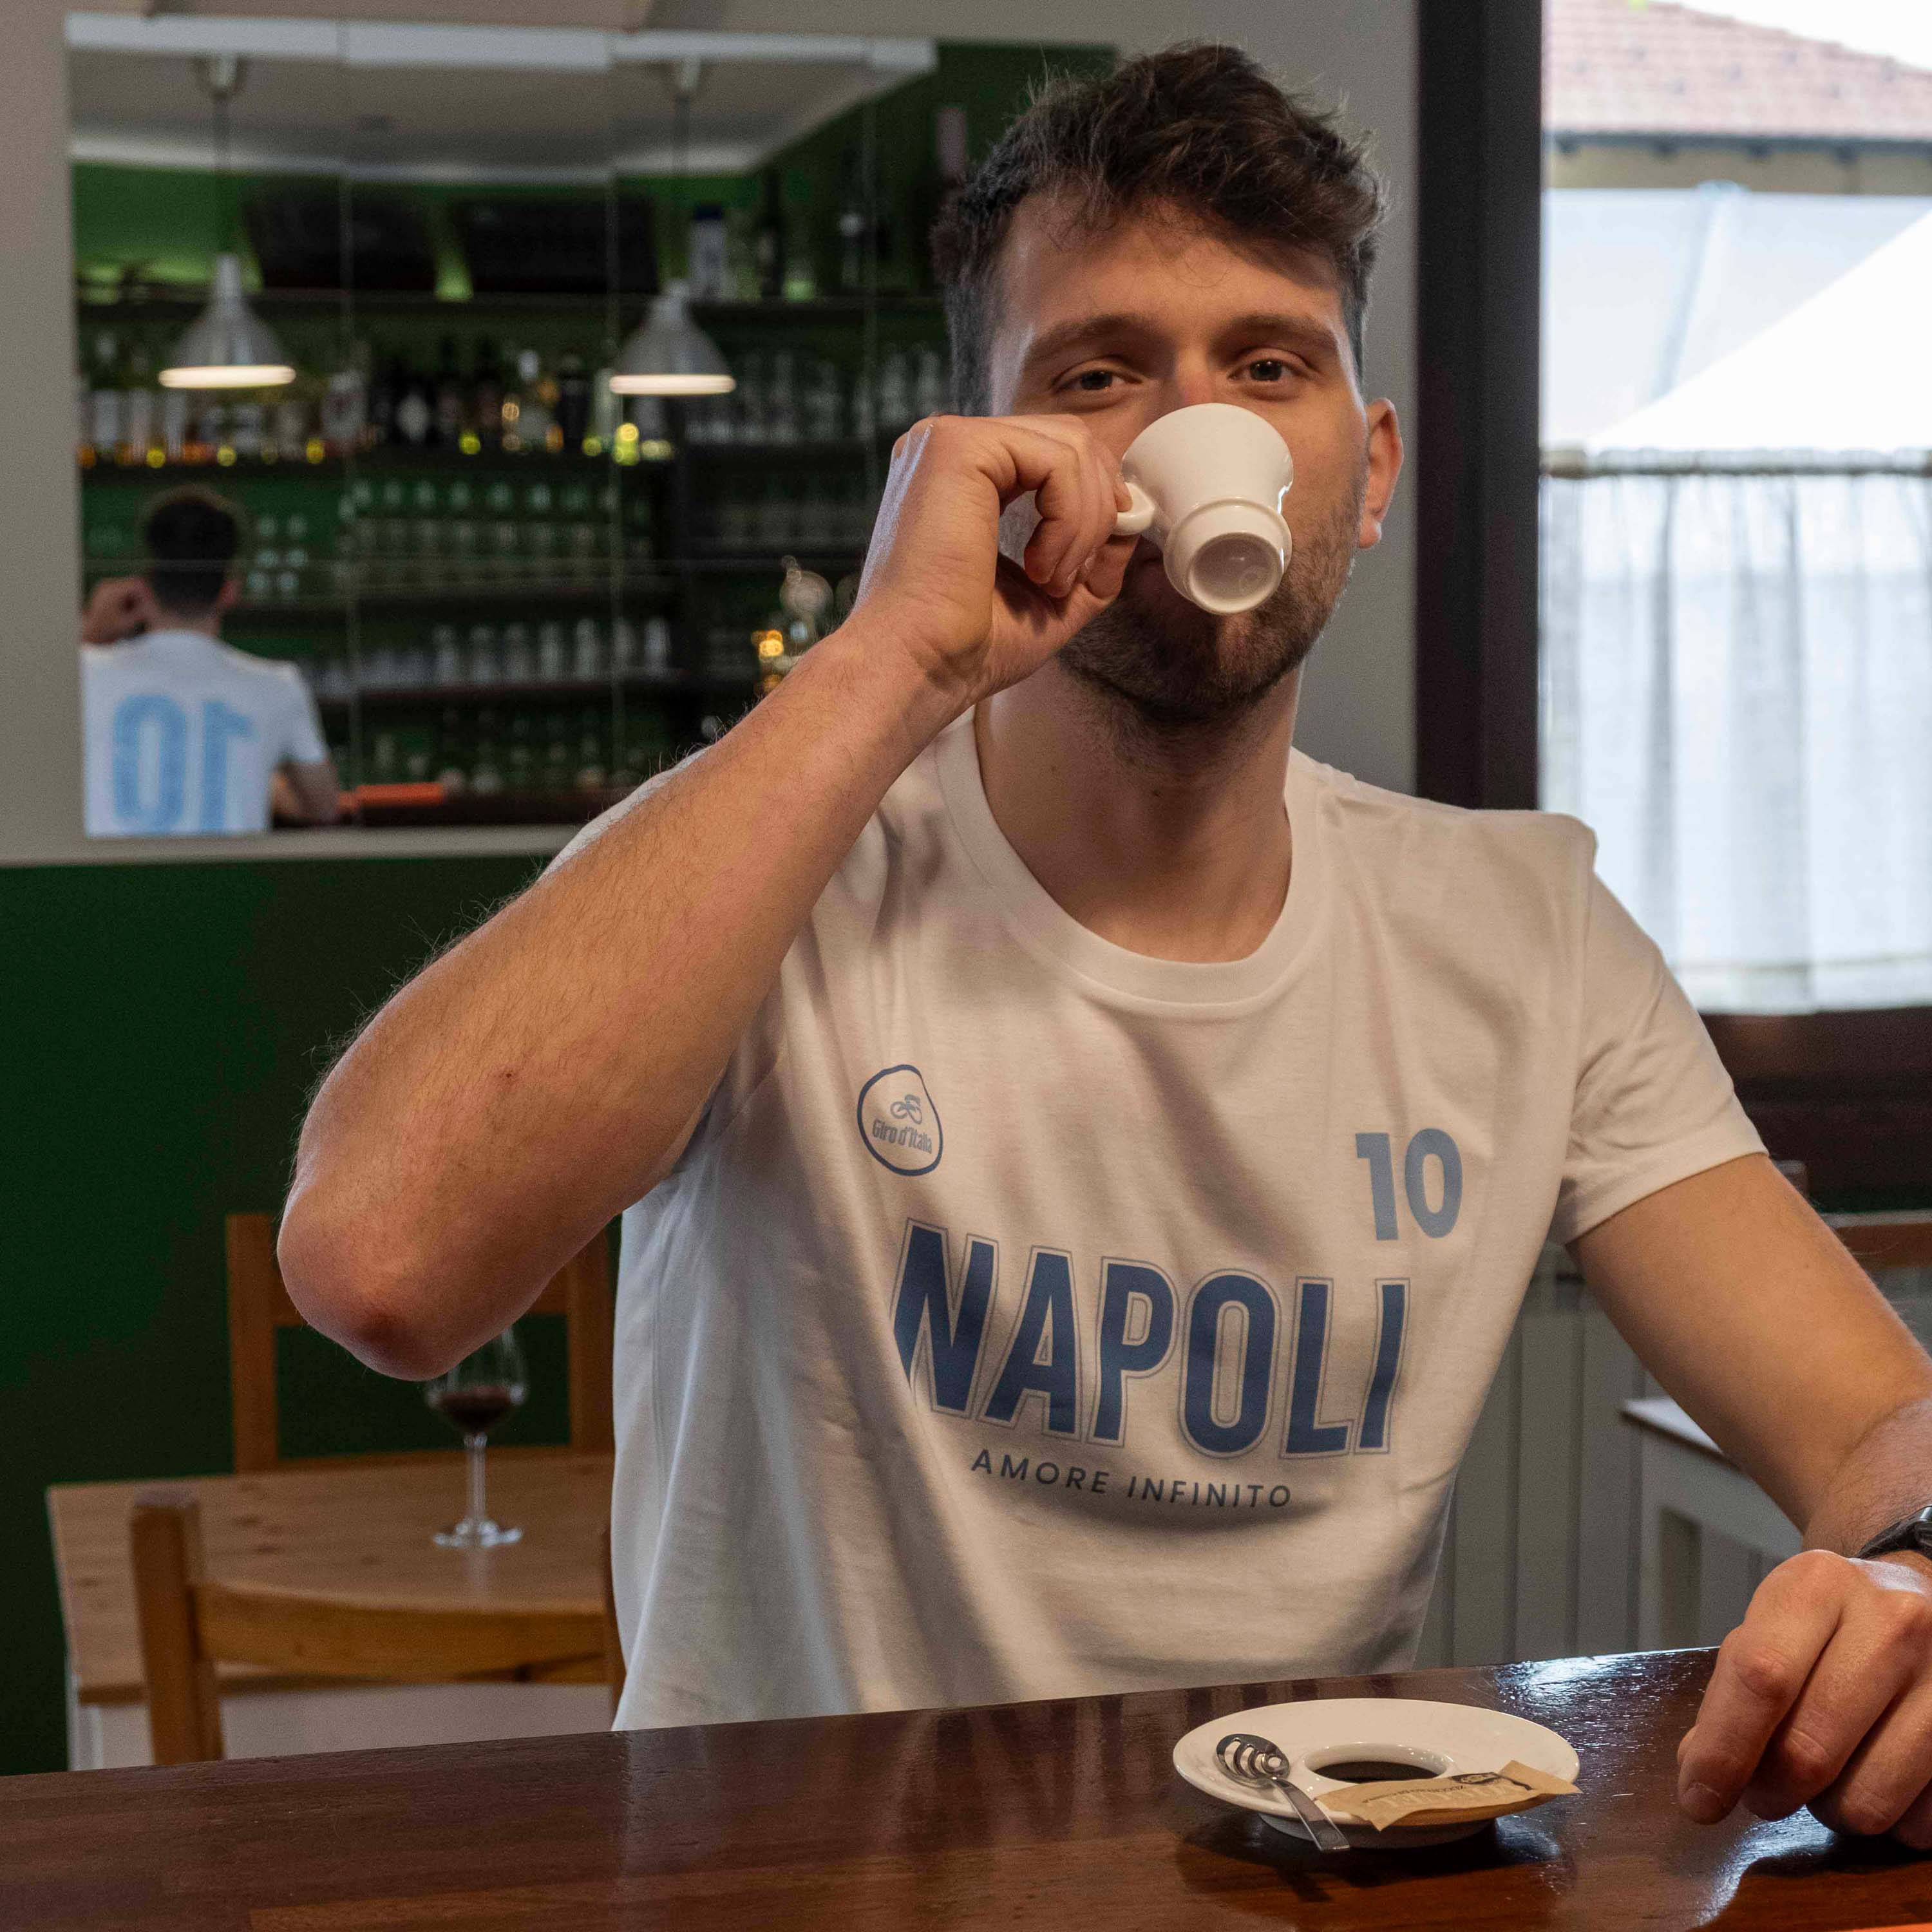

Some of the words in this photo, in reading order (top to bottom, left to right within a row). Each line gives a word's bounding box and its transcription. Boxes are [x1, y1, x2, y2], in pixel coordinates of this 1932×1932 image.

[872, 1119, 898, 1144] Giro
[898, 1125, 933, 1155] d'Italia
[1355, 1128, 1463, 1241] 10
[890, 1218, 1411, 1460] NAPOLI
[971, 1448, 1110, 1495] AMORE
[1126, 1475, 1291, 1508] INFINITO
